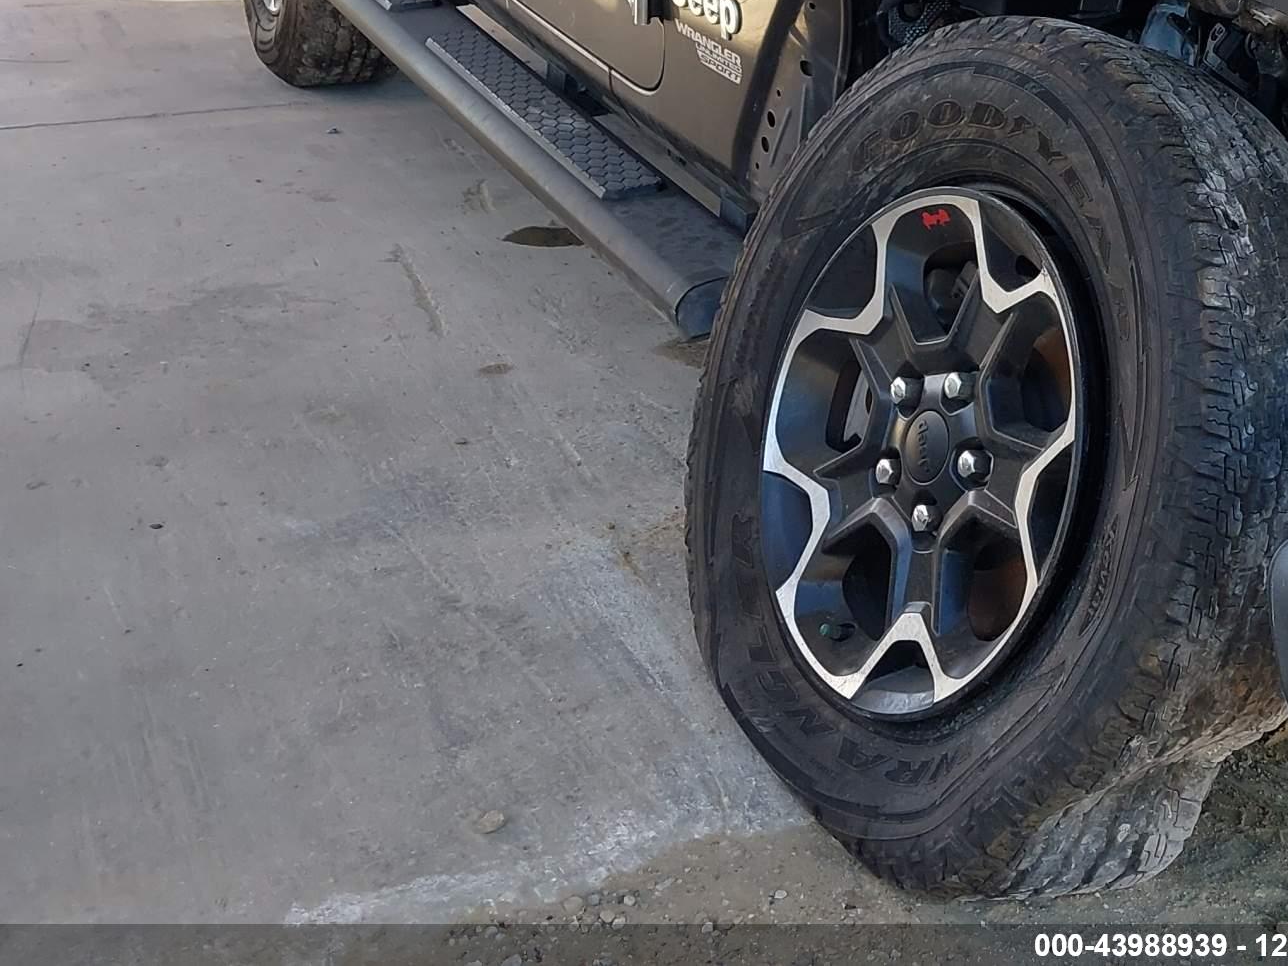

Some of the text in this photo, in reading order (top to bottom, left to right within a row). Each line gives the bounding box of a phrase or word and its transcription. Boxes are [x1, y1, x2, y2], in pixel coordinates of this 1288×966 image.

[674, 17, 742, 67] WRANGLER
[695, 41, 743, 74] UNLIMITED
[699, 54, 741, 84] SPORT
